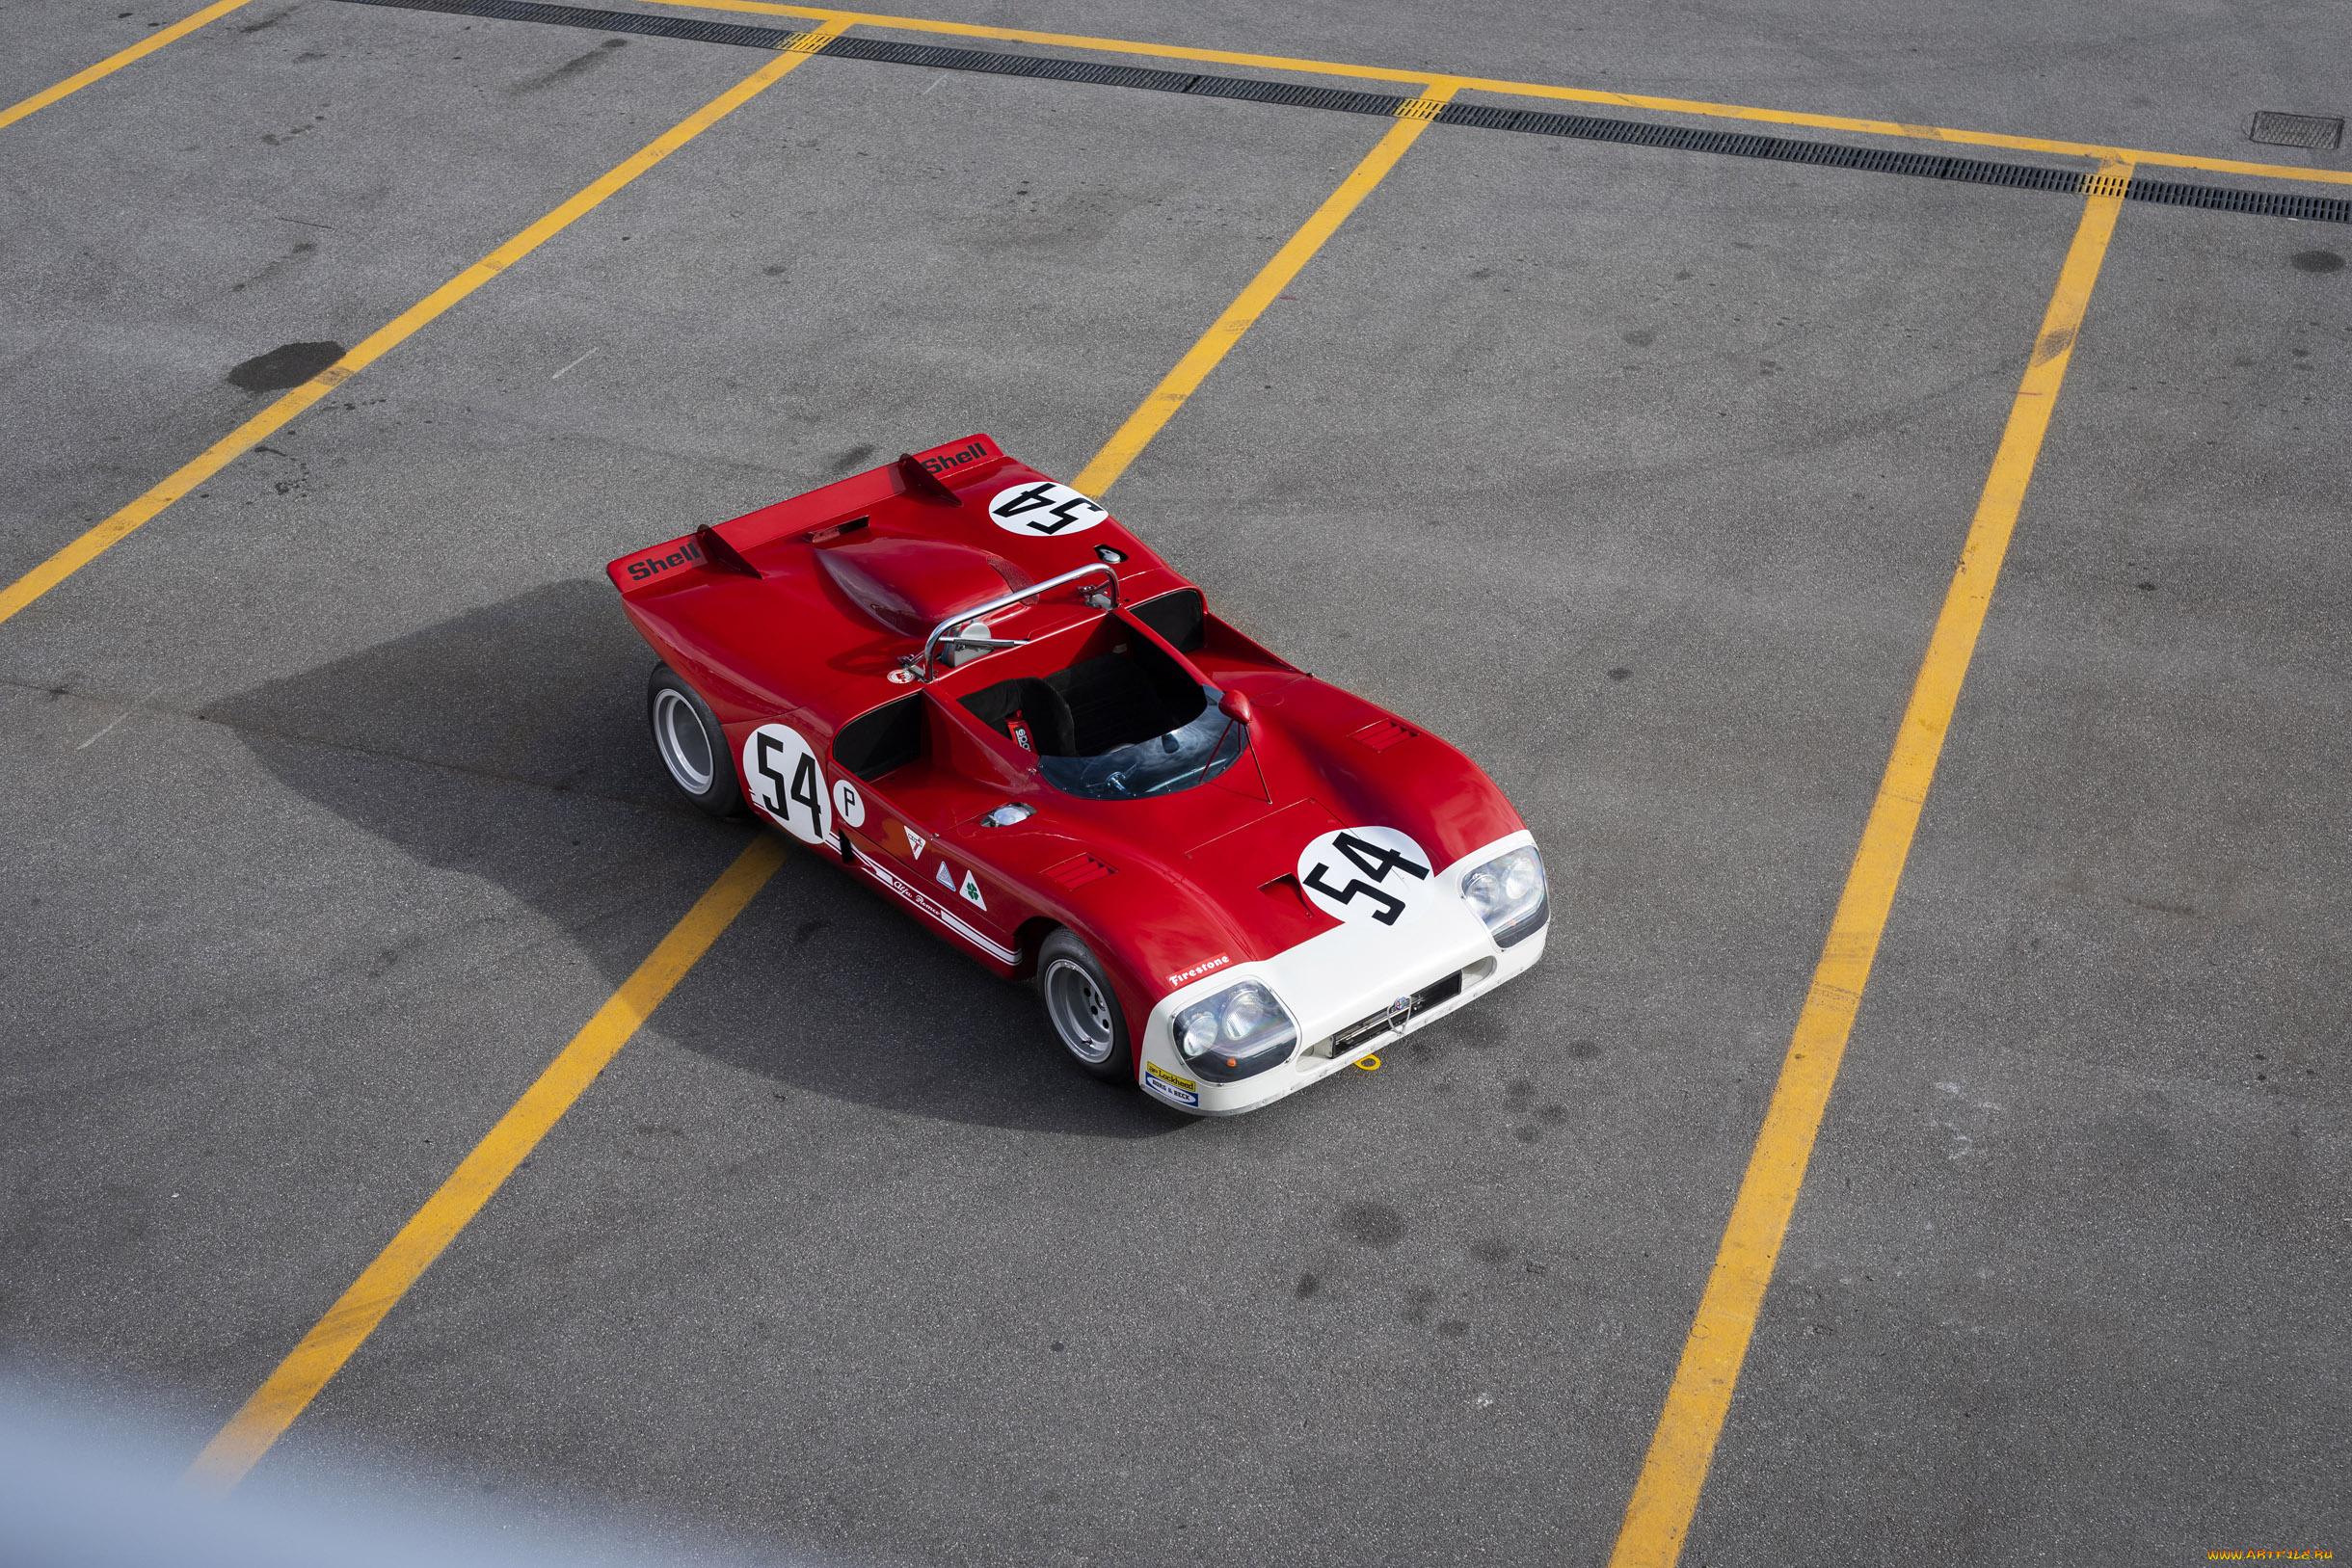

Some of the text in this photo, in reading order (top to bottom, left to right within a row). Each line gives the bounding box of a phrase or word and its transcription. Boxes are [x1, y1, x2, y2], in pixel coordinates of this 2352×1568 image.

[922, 442, 988, 474] Shell
[991, 482, 1105, 536] 54
[627, 543, 701, 581] Shell
[1015, 728, 1031, 752] spa
[757, 731, 824, 840] 54
[843, 786, 856, 817] P
[1302, 832, 1430, 926] 54
[894, 881, 941, 916] Alfa Romeo
[1168, 955, 1230, 987] Firestone
[1159, 1070, 1194, 1090] Lockheed
[1173, 1090, 1190, 1101] BECK
